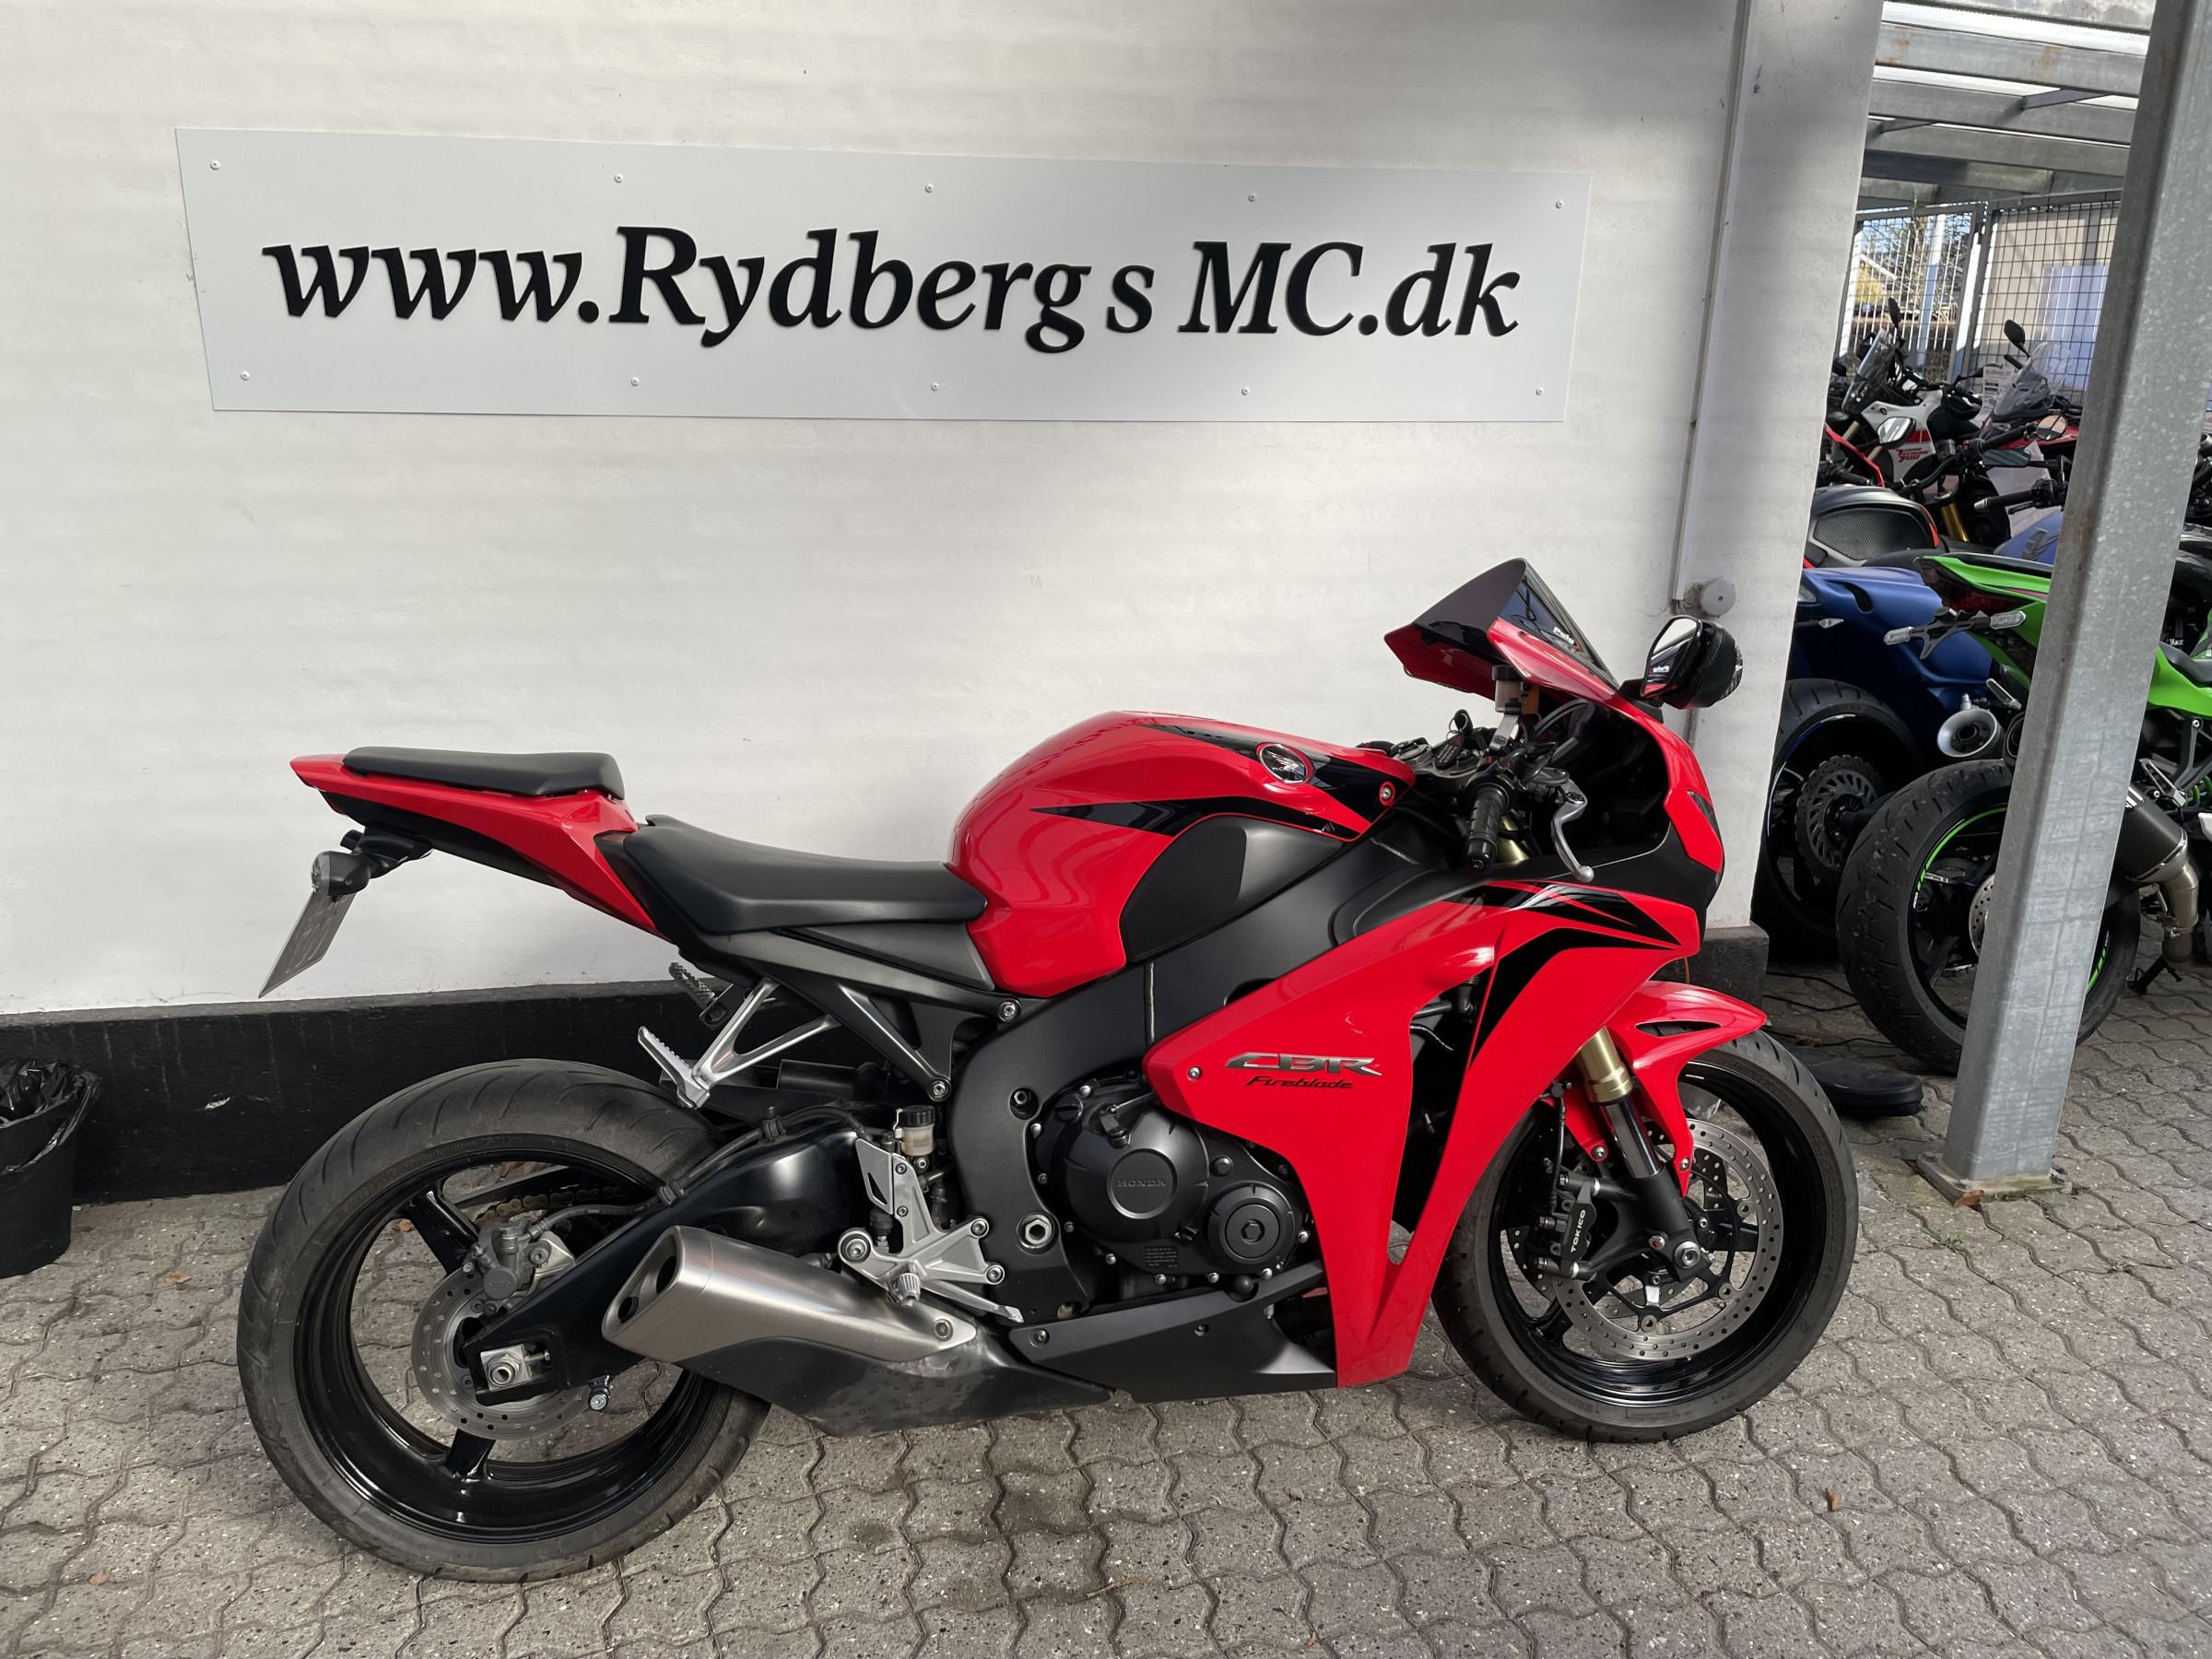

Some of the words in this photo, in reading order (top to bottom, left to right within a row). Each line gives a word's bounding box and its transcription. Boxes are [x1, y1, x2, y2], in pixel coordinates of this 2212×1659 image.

[1177, 241, 1521, 337] MC.dk
[1225, 1052, 1382, 1077] CBR
[1245, 1075, 1354, 1089] Fireblade
[1115, 1179, 1166, 1188] HONDA
[1570, 1209, 1586, 1253] TOKICO
